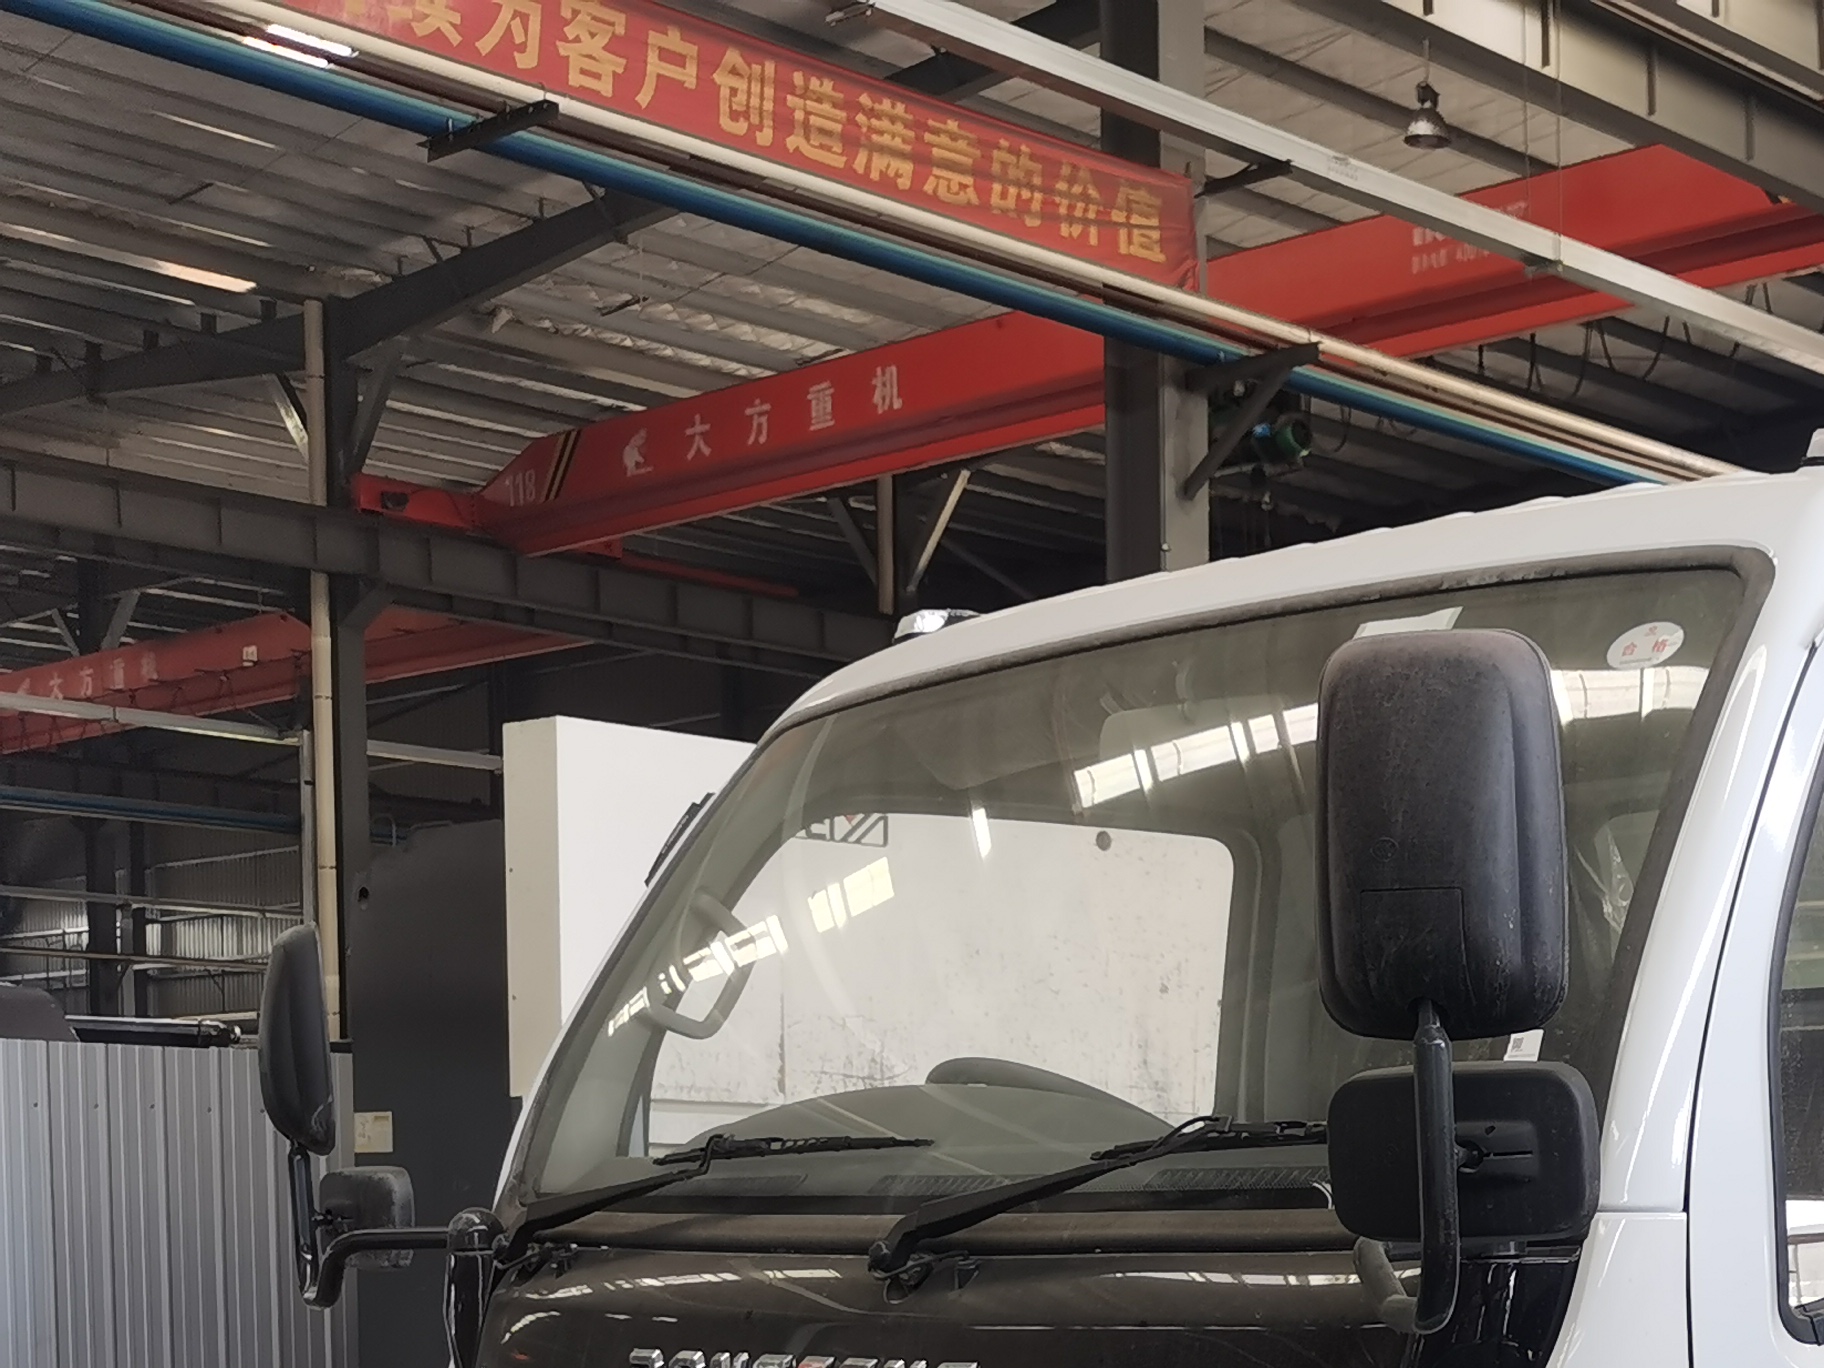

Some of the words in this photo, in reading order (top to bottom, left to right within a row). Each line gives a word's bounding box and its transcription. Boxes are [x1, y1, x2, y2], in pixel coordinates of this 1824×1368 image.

[684, 364, 902, 461] 大方重机
[504, 468, 537, 508] 118
